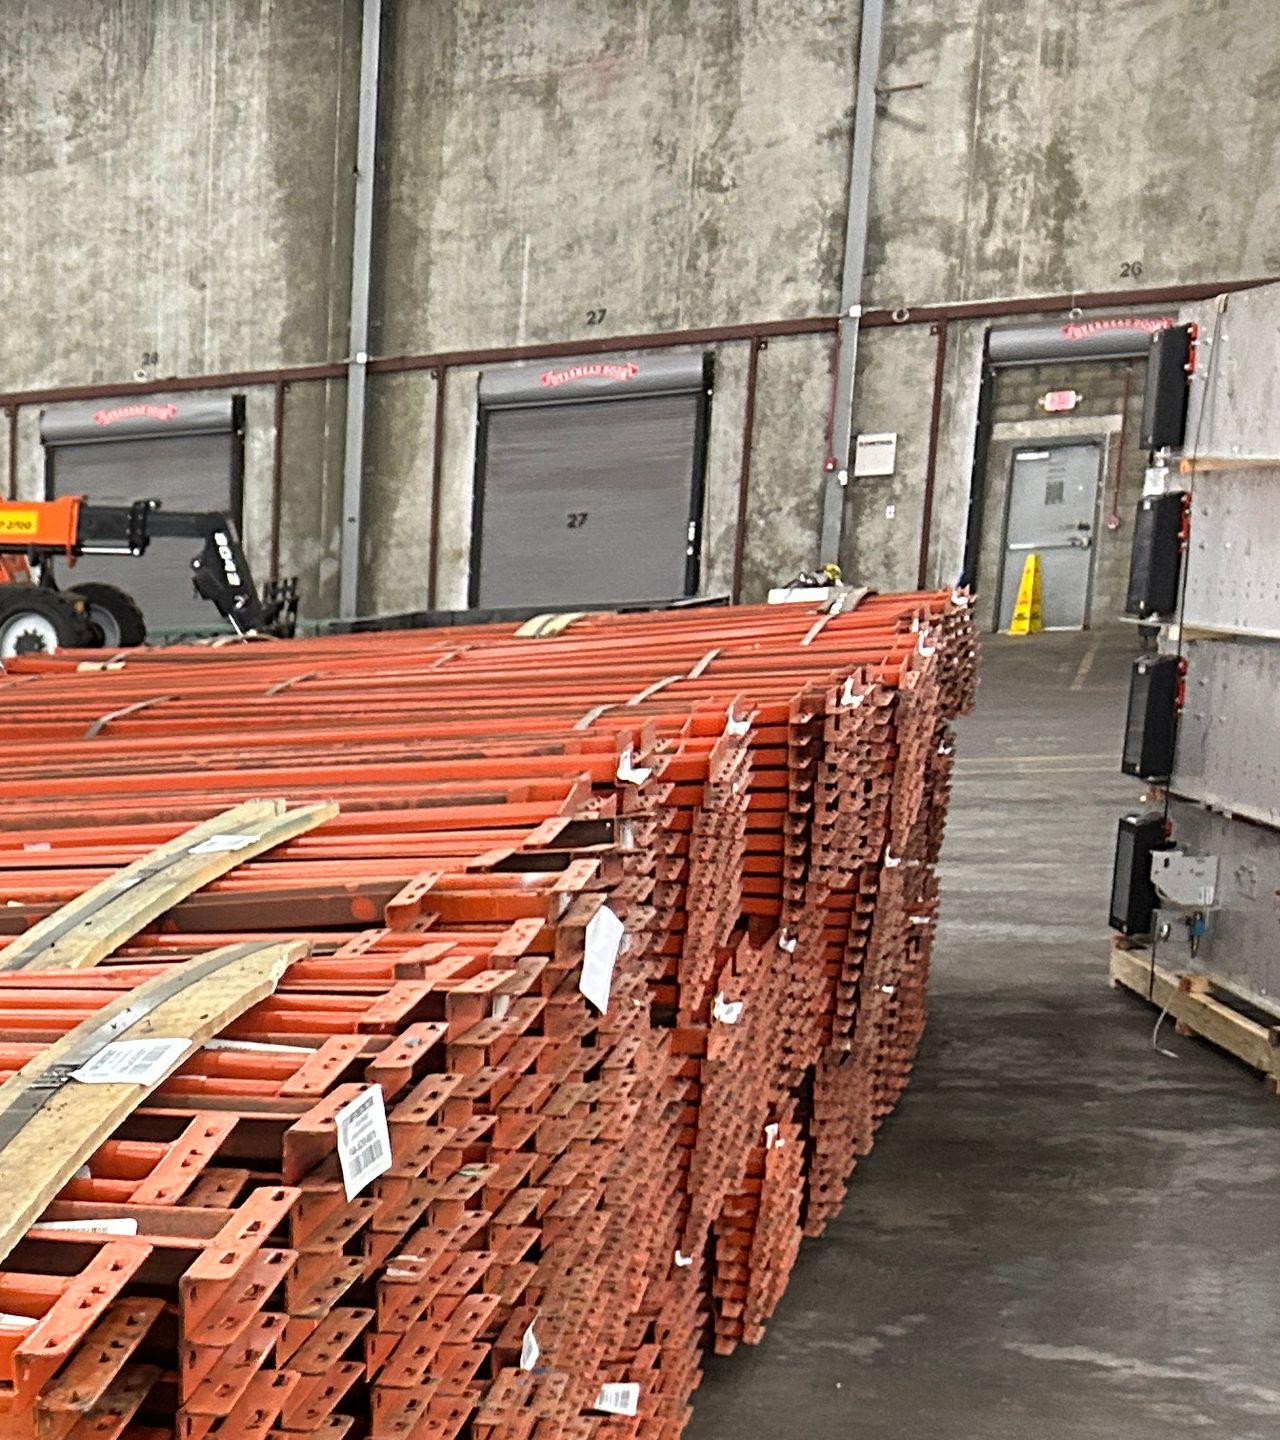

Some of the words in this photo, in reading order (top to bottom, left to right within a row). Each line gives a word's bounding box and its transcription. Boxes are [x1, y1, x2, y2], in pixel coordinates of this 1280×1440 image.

[1119, 261, 1143, 278] 26
[586, 308, 607, 326] 27
[566, 511, 588, 529] 27
